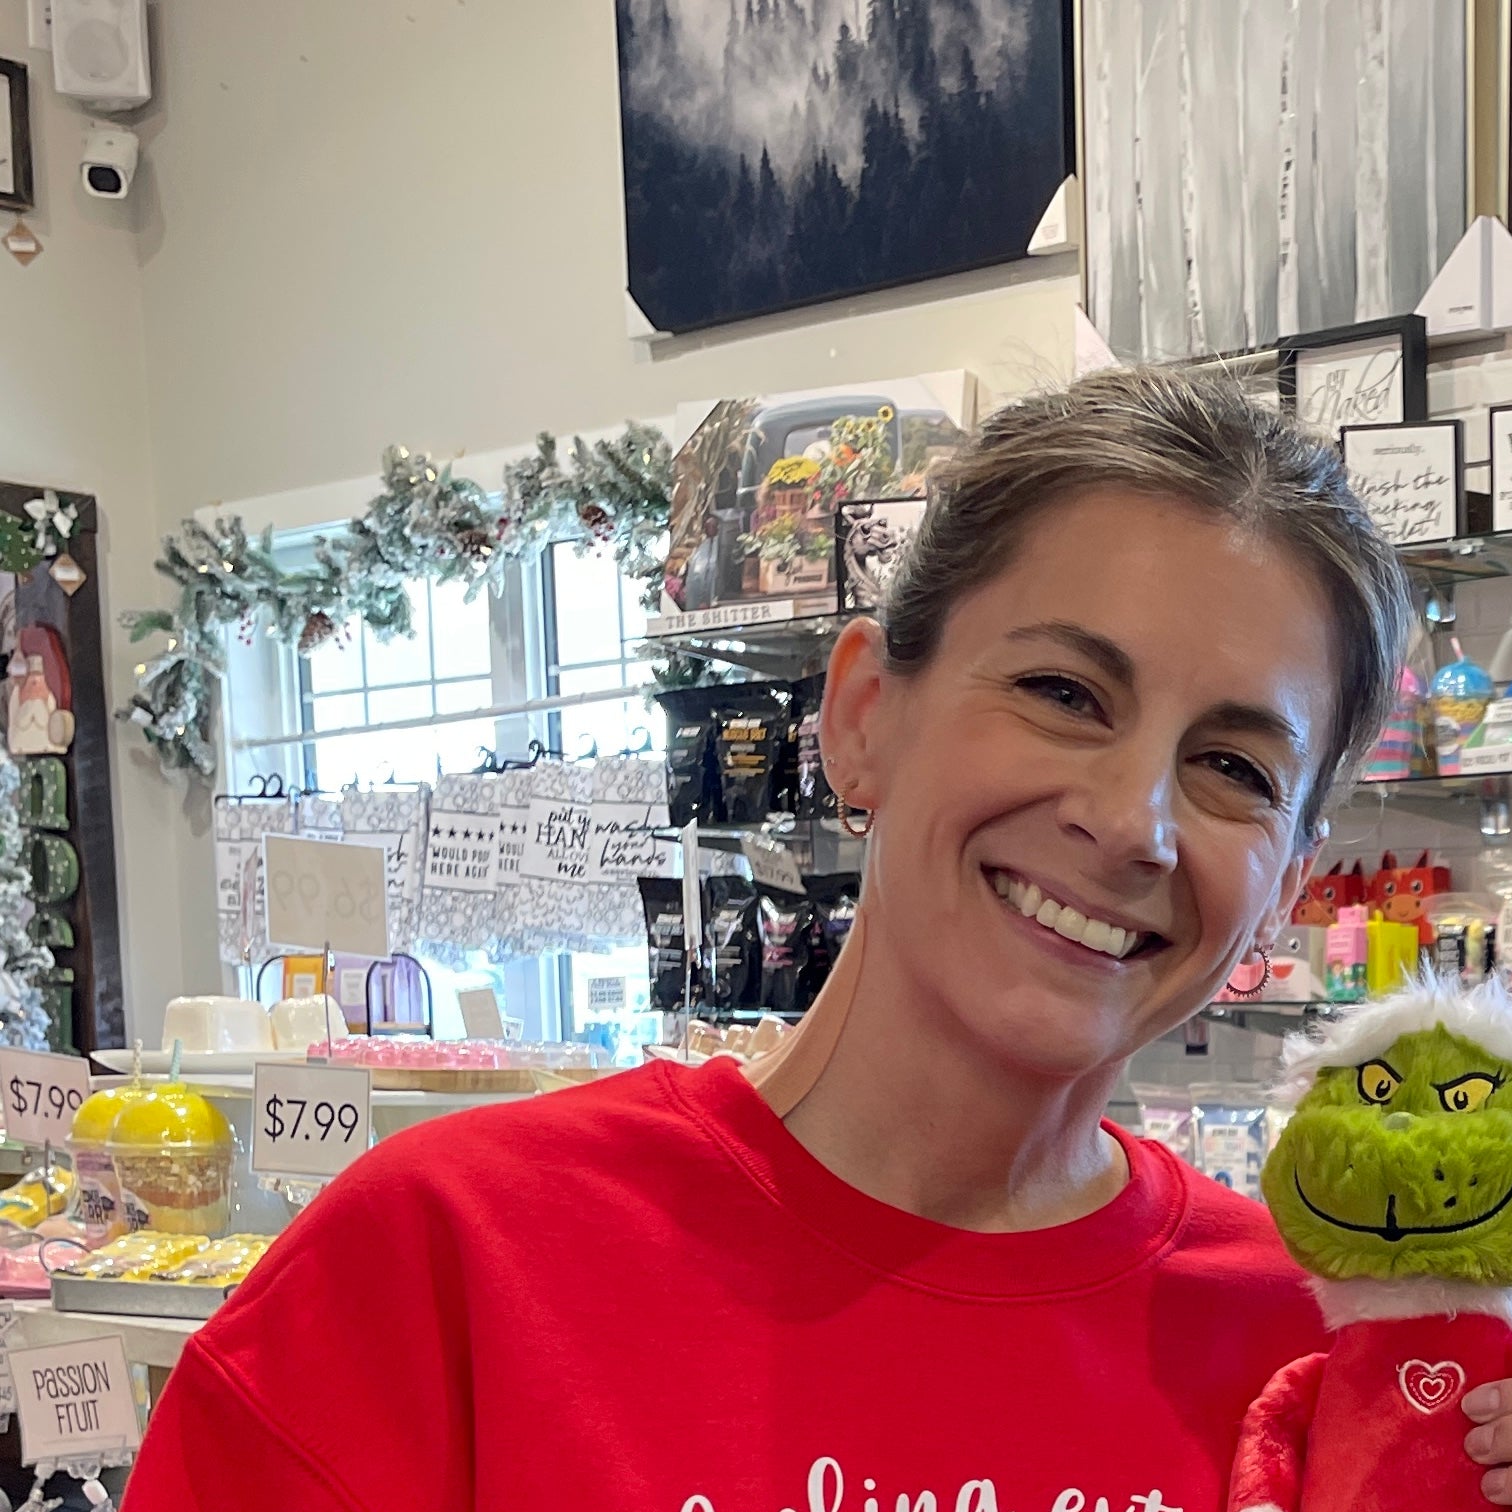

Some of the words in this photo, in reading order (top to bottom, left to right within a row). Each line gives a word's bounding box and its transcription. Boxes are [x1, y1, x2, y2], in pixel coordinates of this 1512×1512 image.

[1413, 464, 1451, 490] the
[665, 613, 696, 630] THE
[702, 604, 772, 625] SHITTER
[264, 1094, 360, 1144] $7.99
